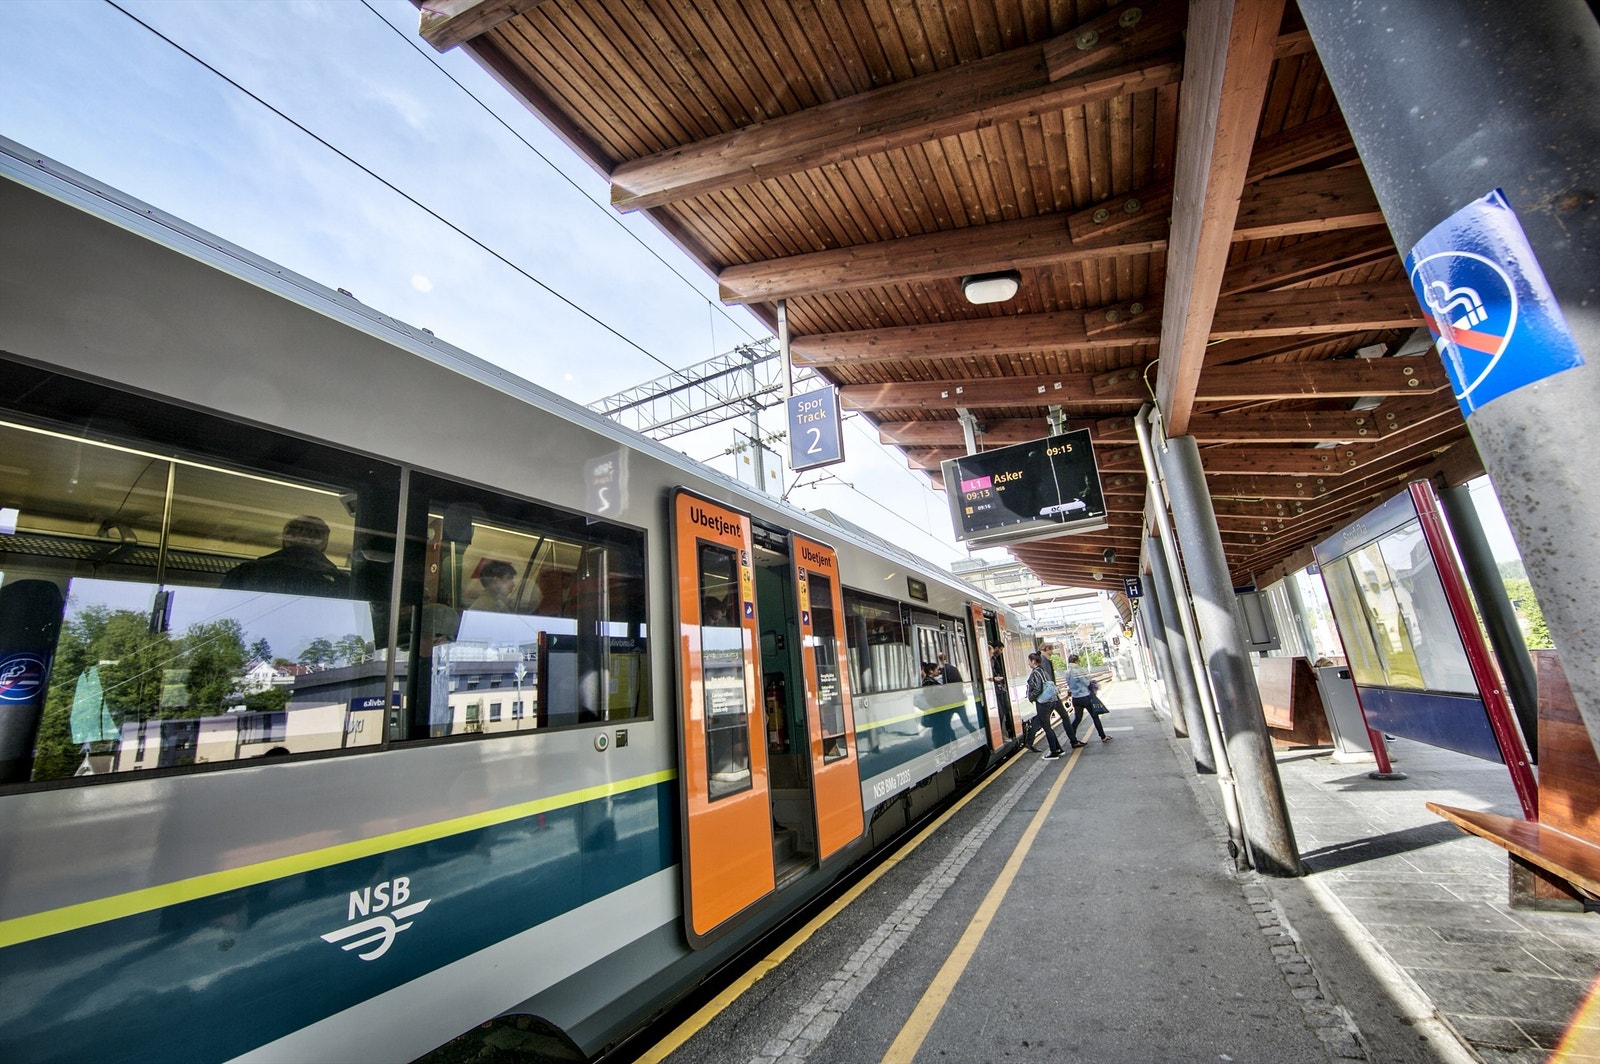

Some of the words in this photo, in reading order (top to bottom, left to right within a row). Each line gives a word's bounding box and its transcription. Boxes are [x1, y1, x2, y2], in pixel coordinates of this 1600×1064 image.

[798, 398, 823, 413] Spor
[796, 409, 827, 424] Track
[806, 427, 823, 455] 2
[1046, 443, 1073, 457] 09:15
[970, 480, 982, 489] L1
[993, 469, 1024, 485] Asker
[966, 490, 990, 501] 09:13
[690, 505, 741, 538] Ubetjent
[801, 546, 832, 568] Ubetjent
[1129, 585, 1138, 596] H
[873, 780, 886, 800] NSB
[347, 876, 411, 921] NSB
